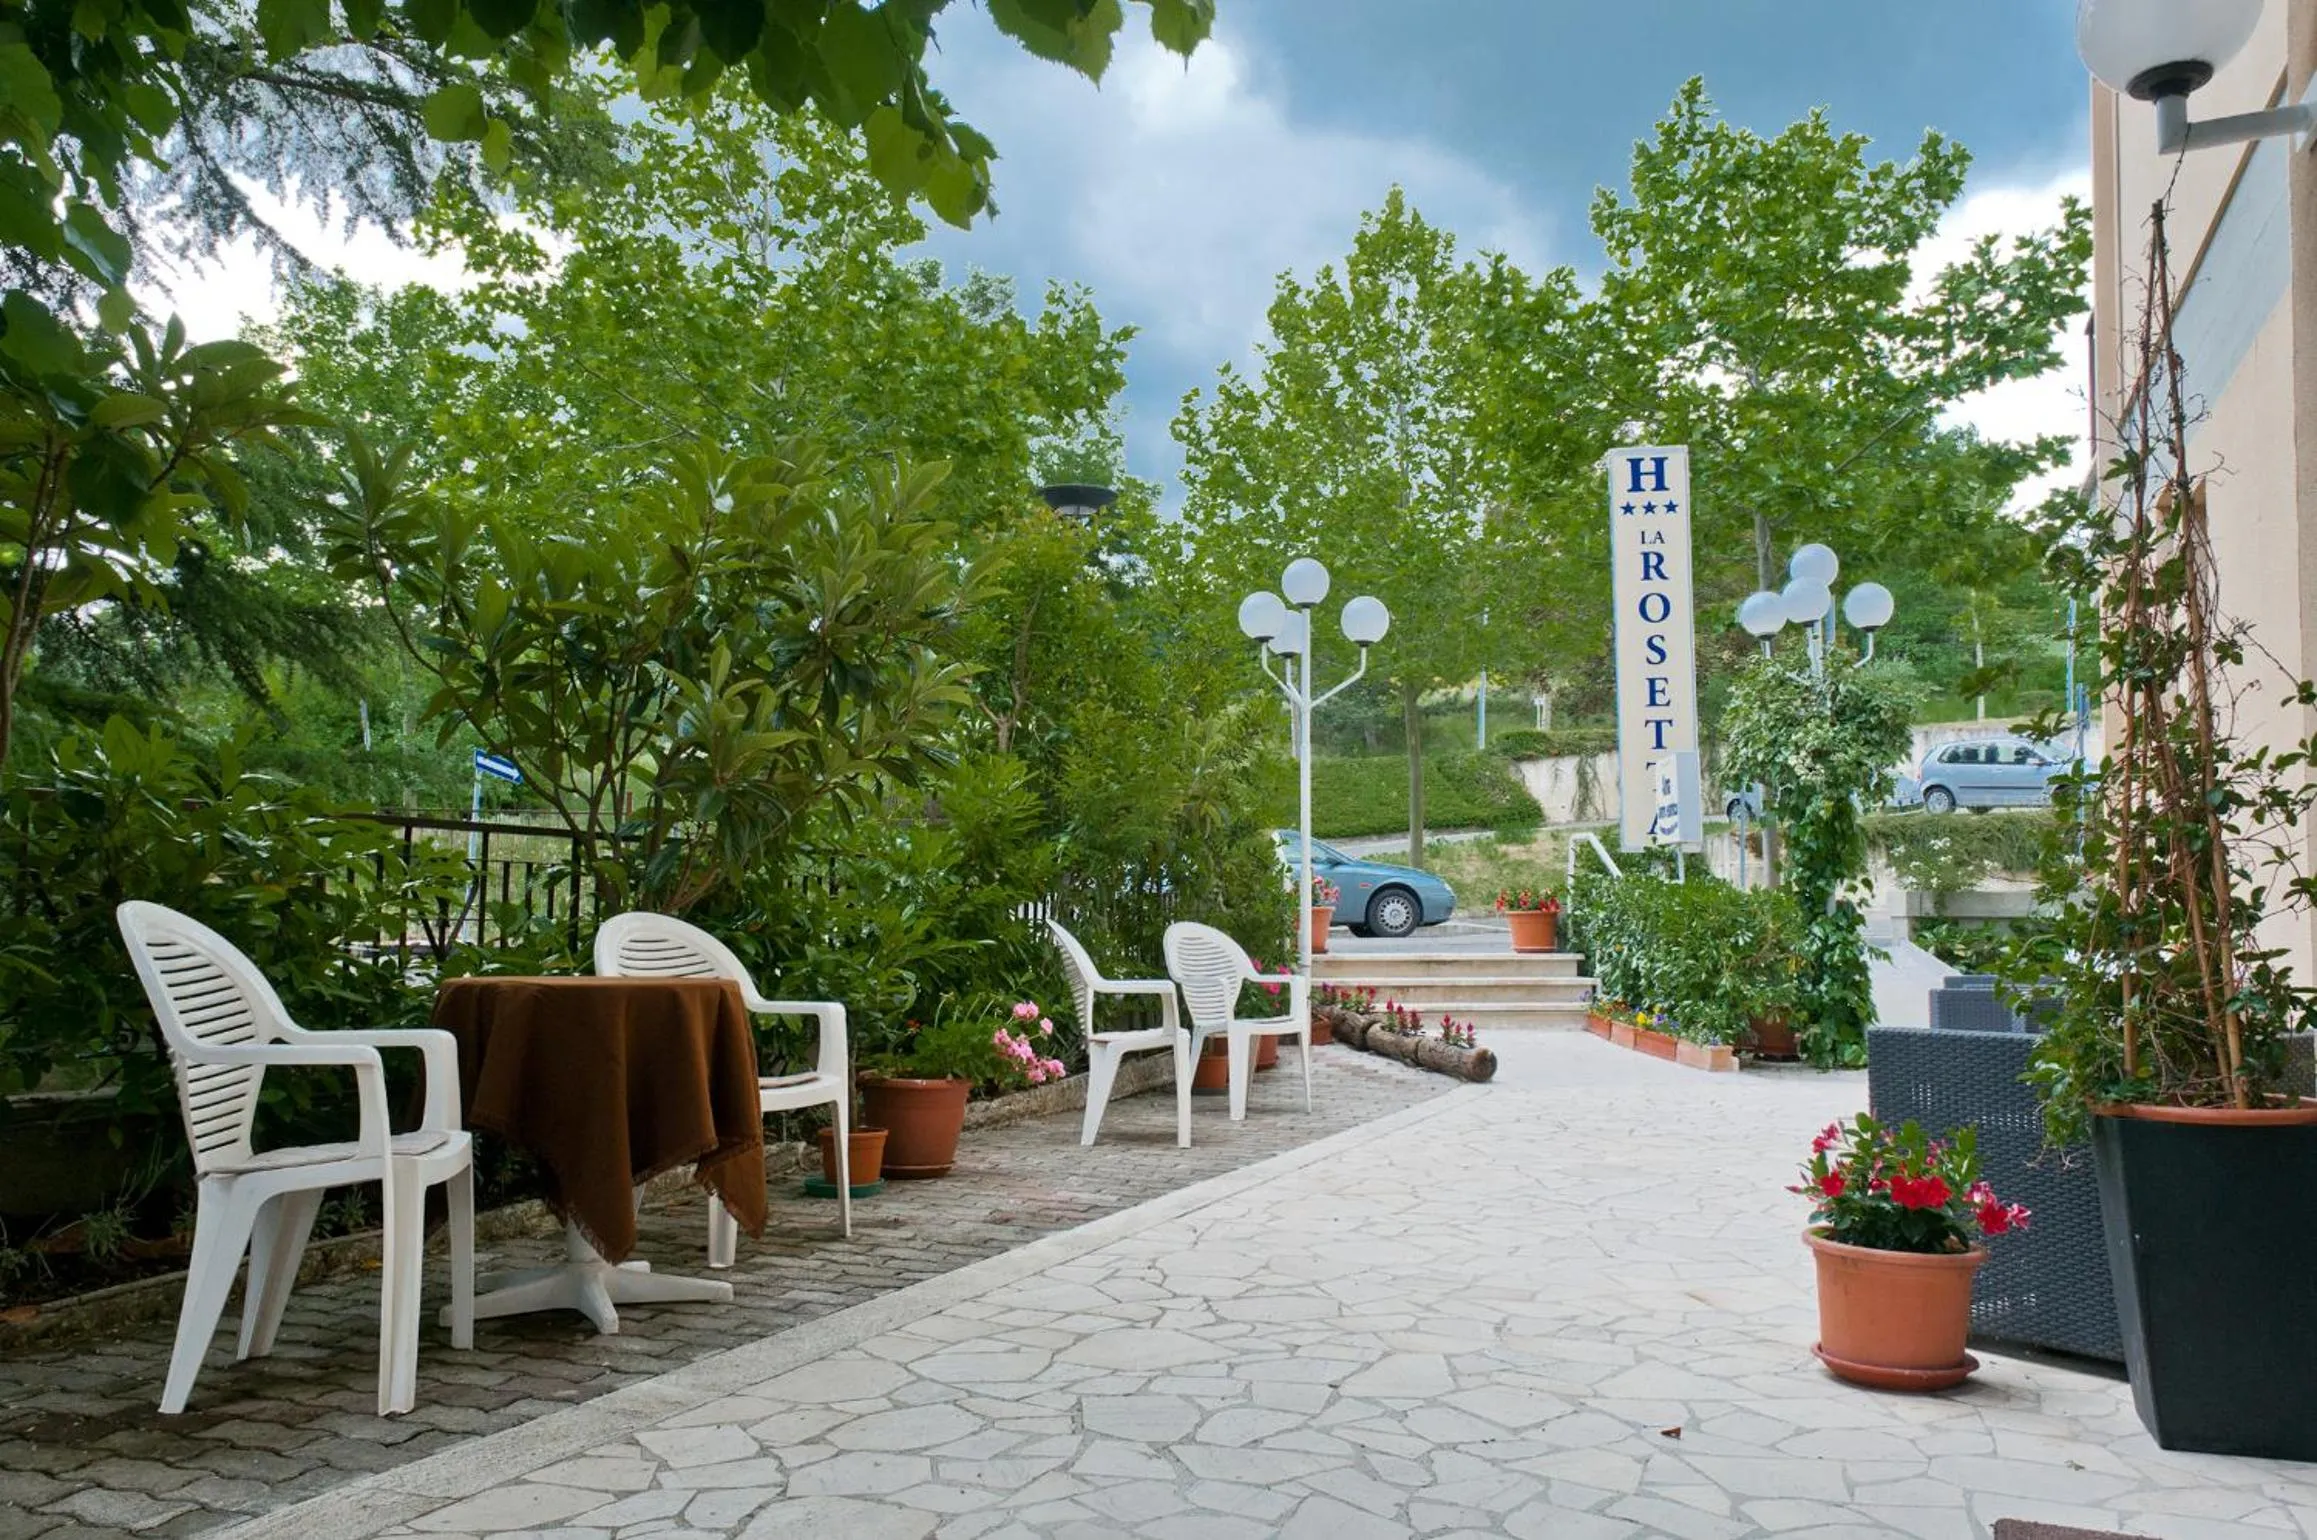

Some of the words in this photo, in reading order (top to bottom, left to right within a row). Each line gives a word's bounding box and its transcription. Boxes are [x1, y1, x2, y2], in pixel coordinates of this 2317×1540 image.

[1626, 457, 1671, 493] H
[1640, 531, 1666, 545] LA
[1638, 551, 1674, 835] ROSET
